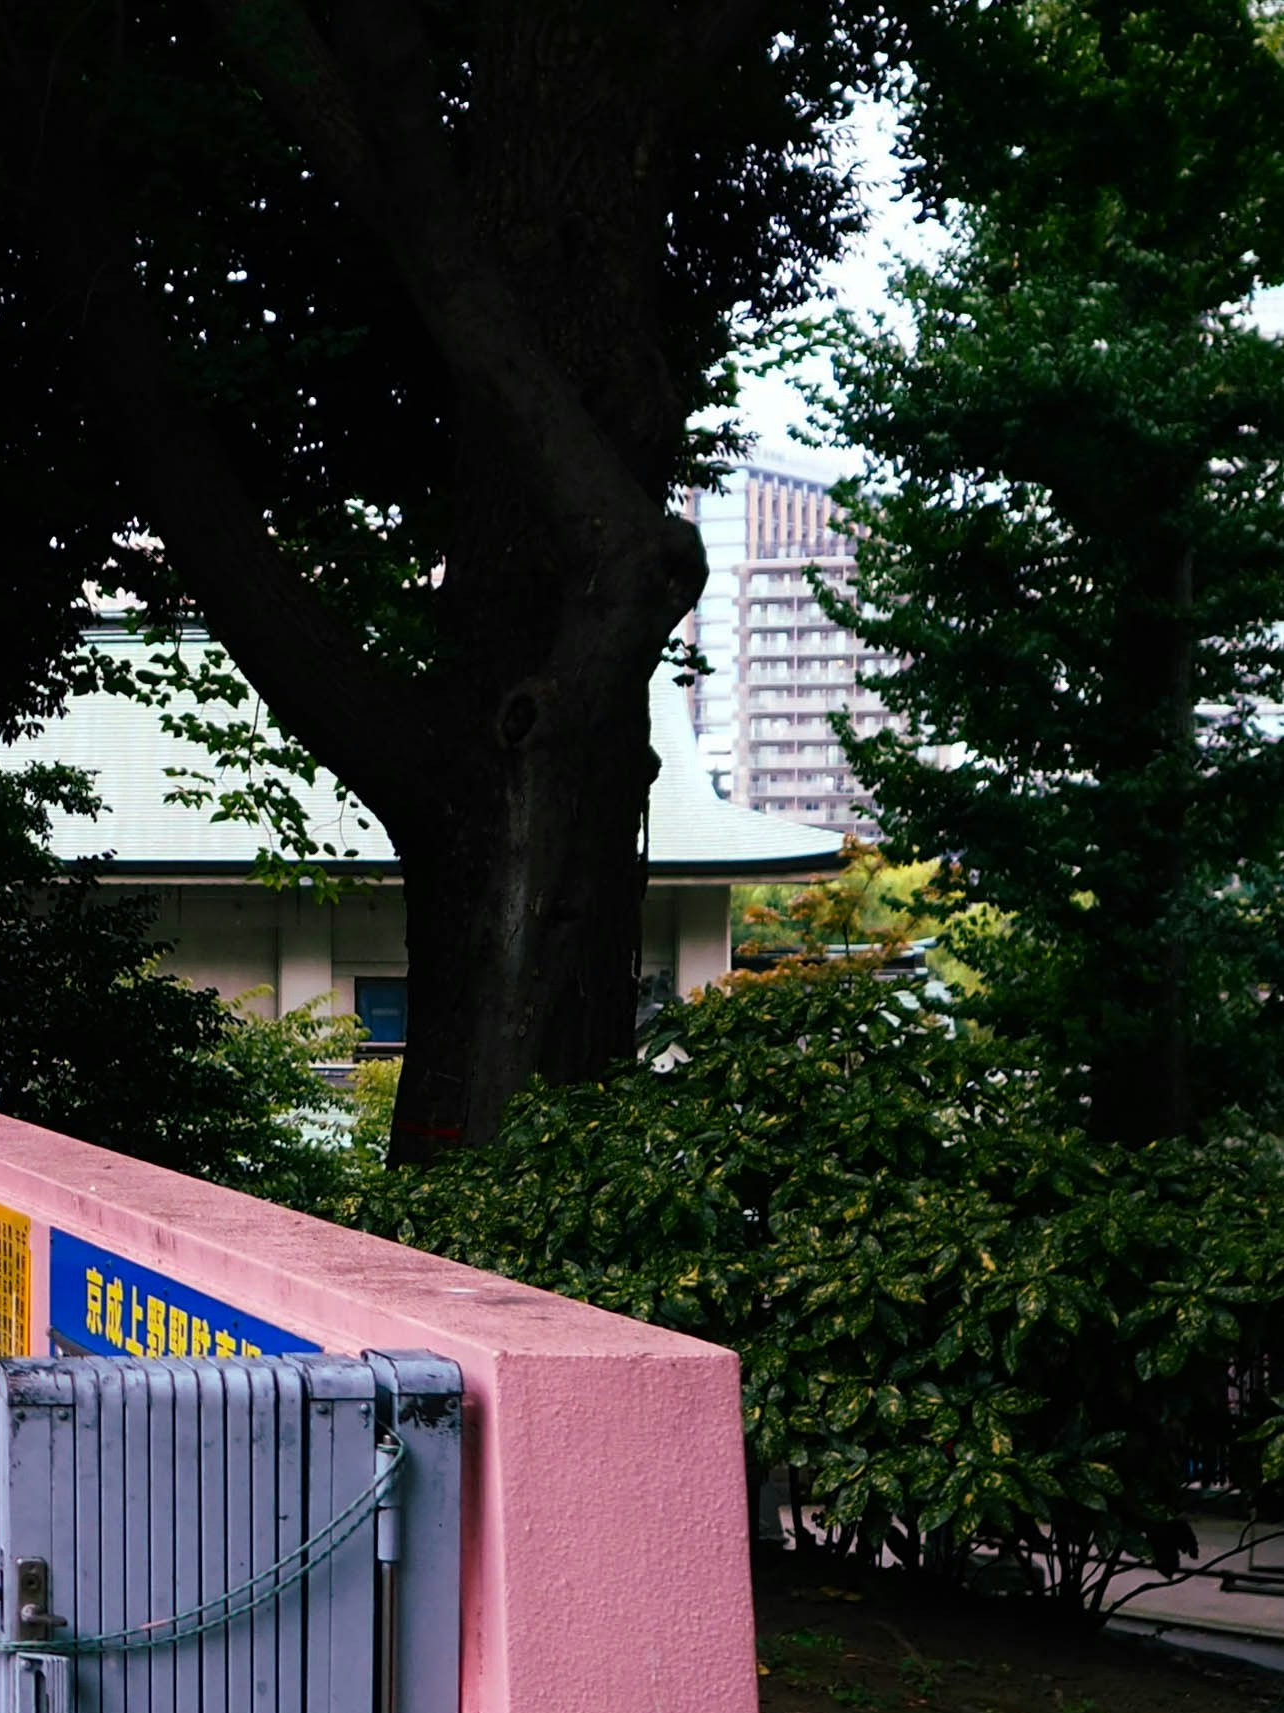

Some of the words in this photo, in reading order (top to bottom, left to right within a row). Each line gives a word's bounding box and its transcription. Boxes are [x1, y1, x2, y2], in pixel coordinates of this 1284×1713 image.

[86, 1266, 263, 1360] 京成上野駅駐
